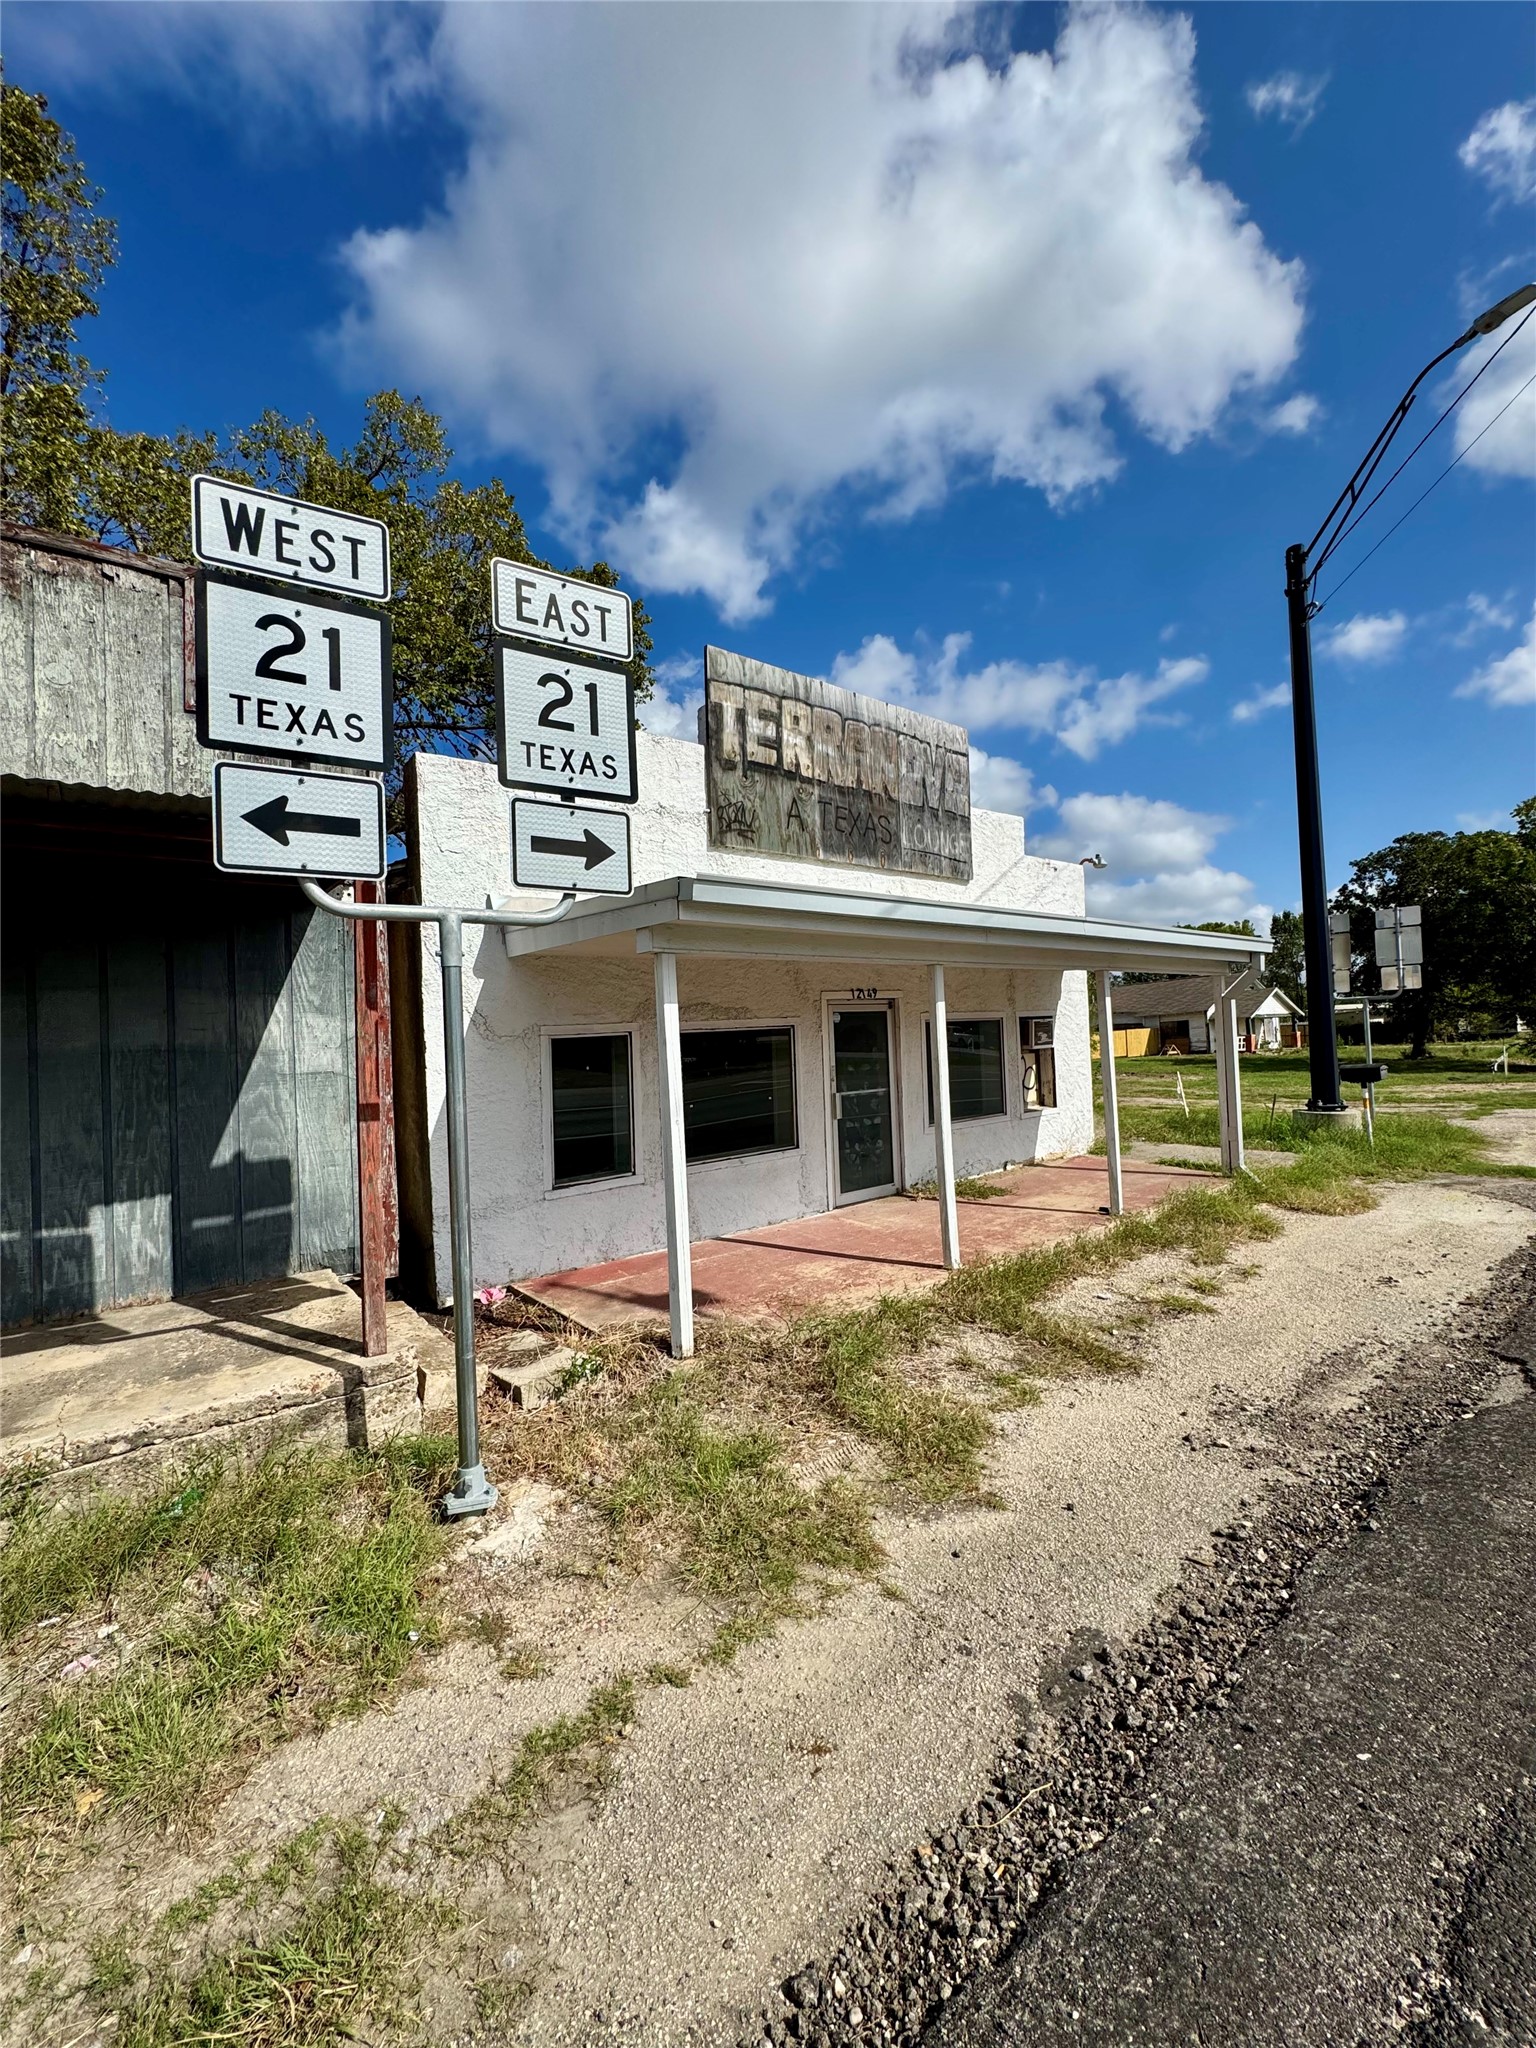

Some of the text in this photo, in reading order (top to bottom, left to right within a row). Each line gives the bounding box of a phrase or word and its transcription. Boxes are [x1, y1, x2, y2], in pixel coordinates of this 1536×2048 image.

[220, 497, 367, 580] WEST
[515, 577, 612, 642] EAST
[254, 613, 342, 692] 21
[228, 693, 366, 743] TEXAS
[537, 672, 600, 737] 21
[520, 741, 618, 780] TEXAS
[786, 797, 805, 832] A
[818, 800, 892, 845] TEXAS
[851, 988, 877, 999] 12149
